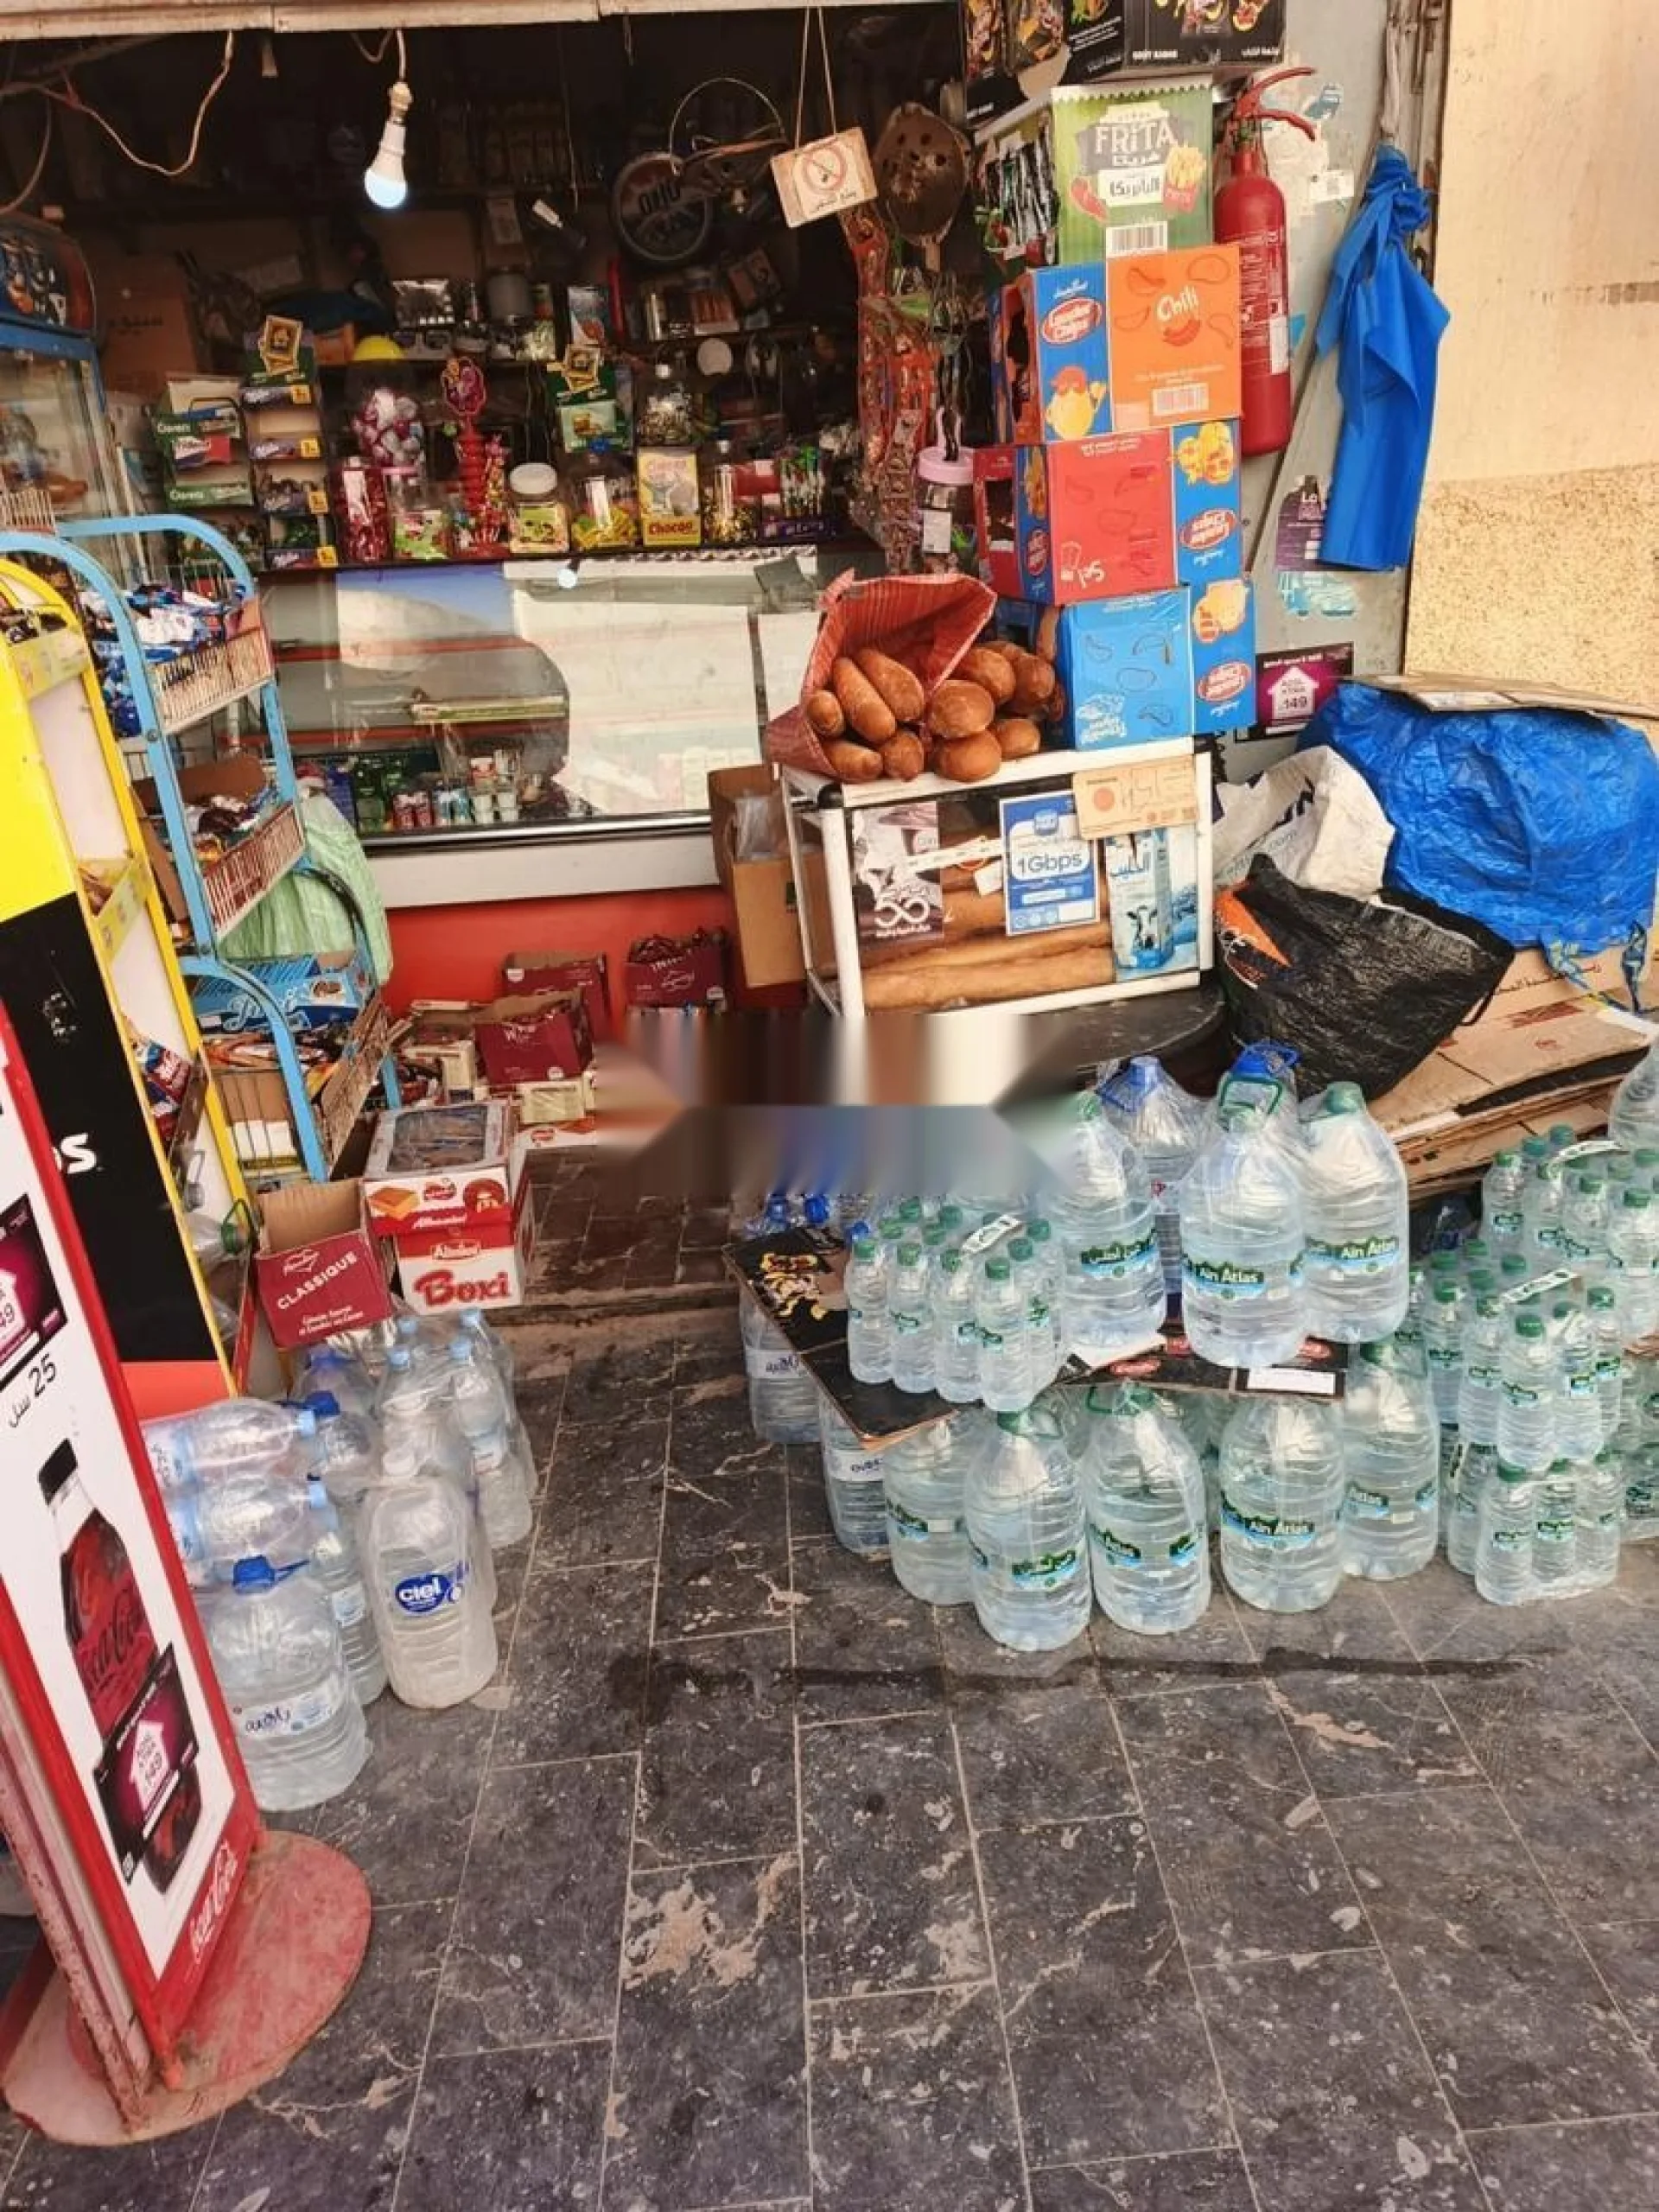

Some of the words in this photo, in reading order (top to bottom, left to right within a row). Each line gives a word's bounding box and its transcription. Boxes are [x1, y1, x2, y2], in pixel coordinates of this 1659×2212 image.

[1017, 852, 1083, 873] 1Gbps
[276, 1250, 358, 1310] CLASSIQUE
[414, 1269, 510, 1306] Boxi
[28, 1353, 57, 1397] 25
